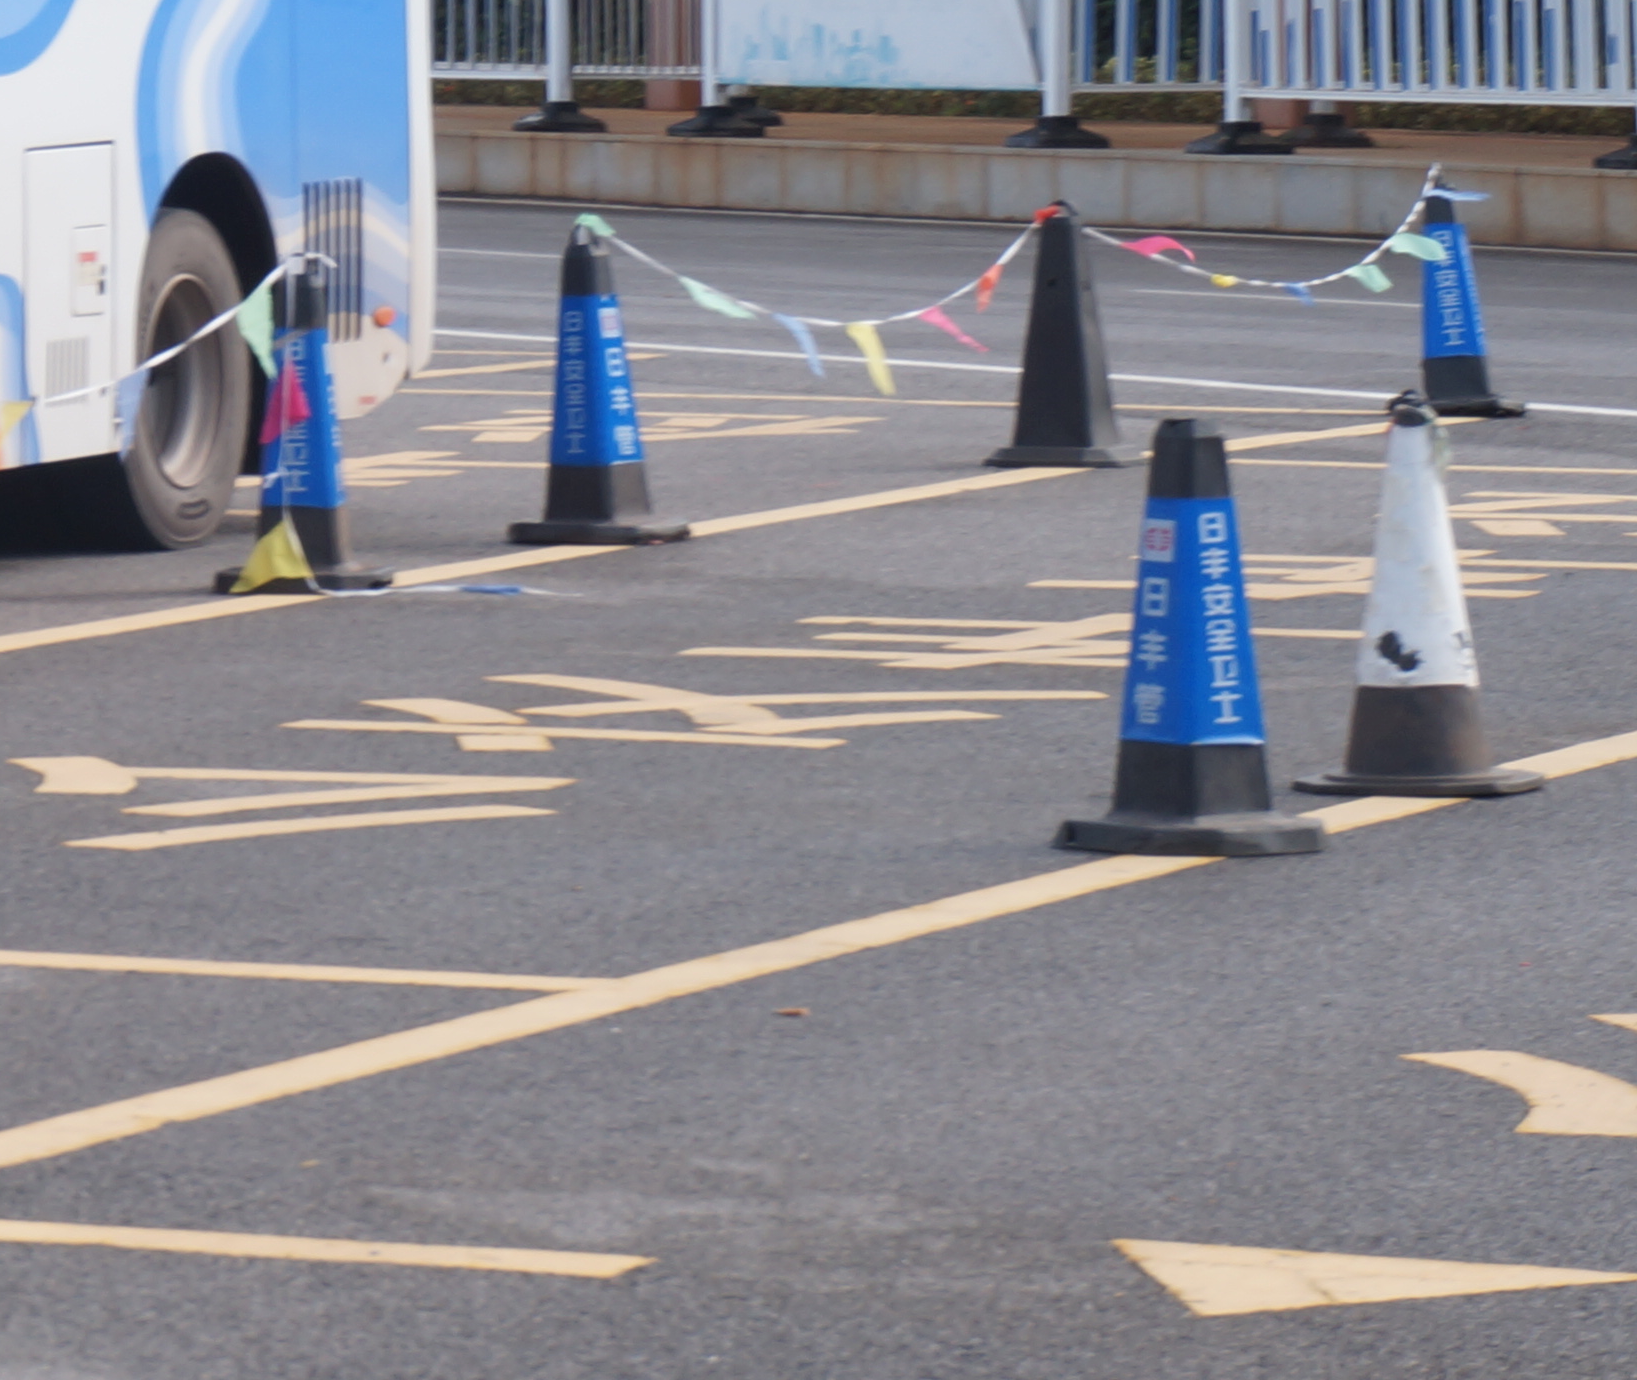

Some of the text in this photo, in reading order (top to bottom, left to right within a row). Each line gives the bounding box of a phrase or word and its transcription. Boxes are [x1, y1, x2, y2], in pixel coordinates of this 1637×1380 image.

[1197, 511, 1244, 724] 日丰安全卫士
